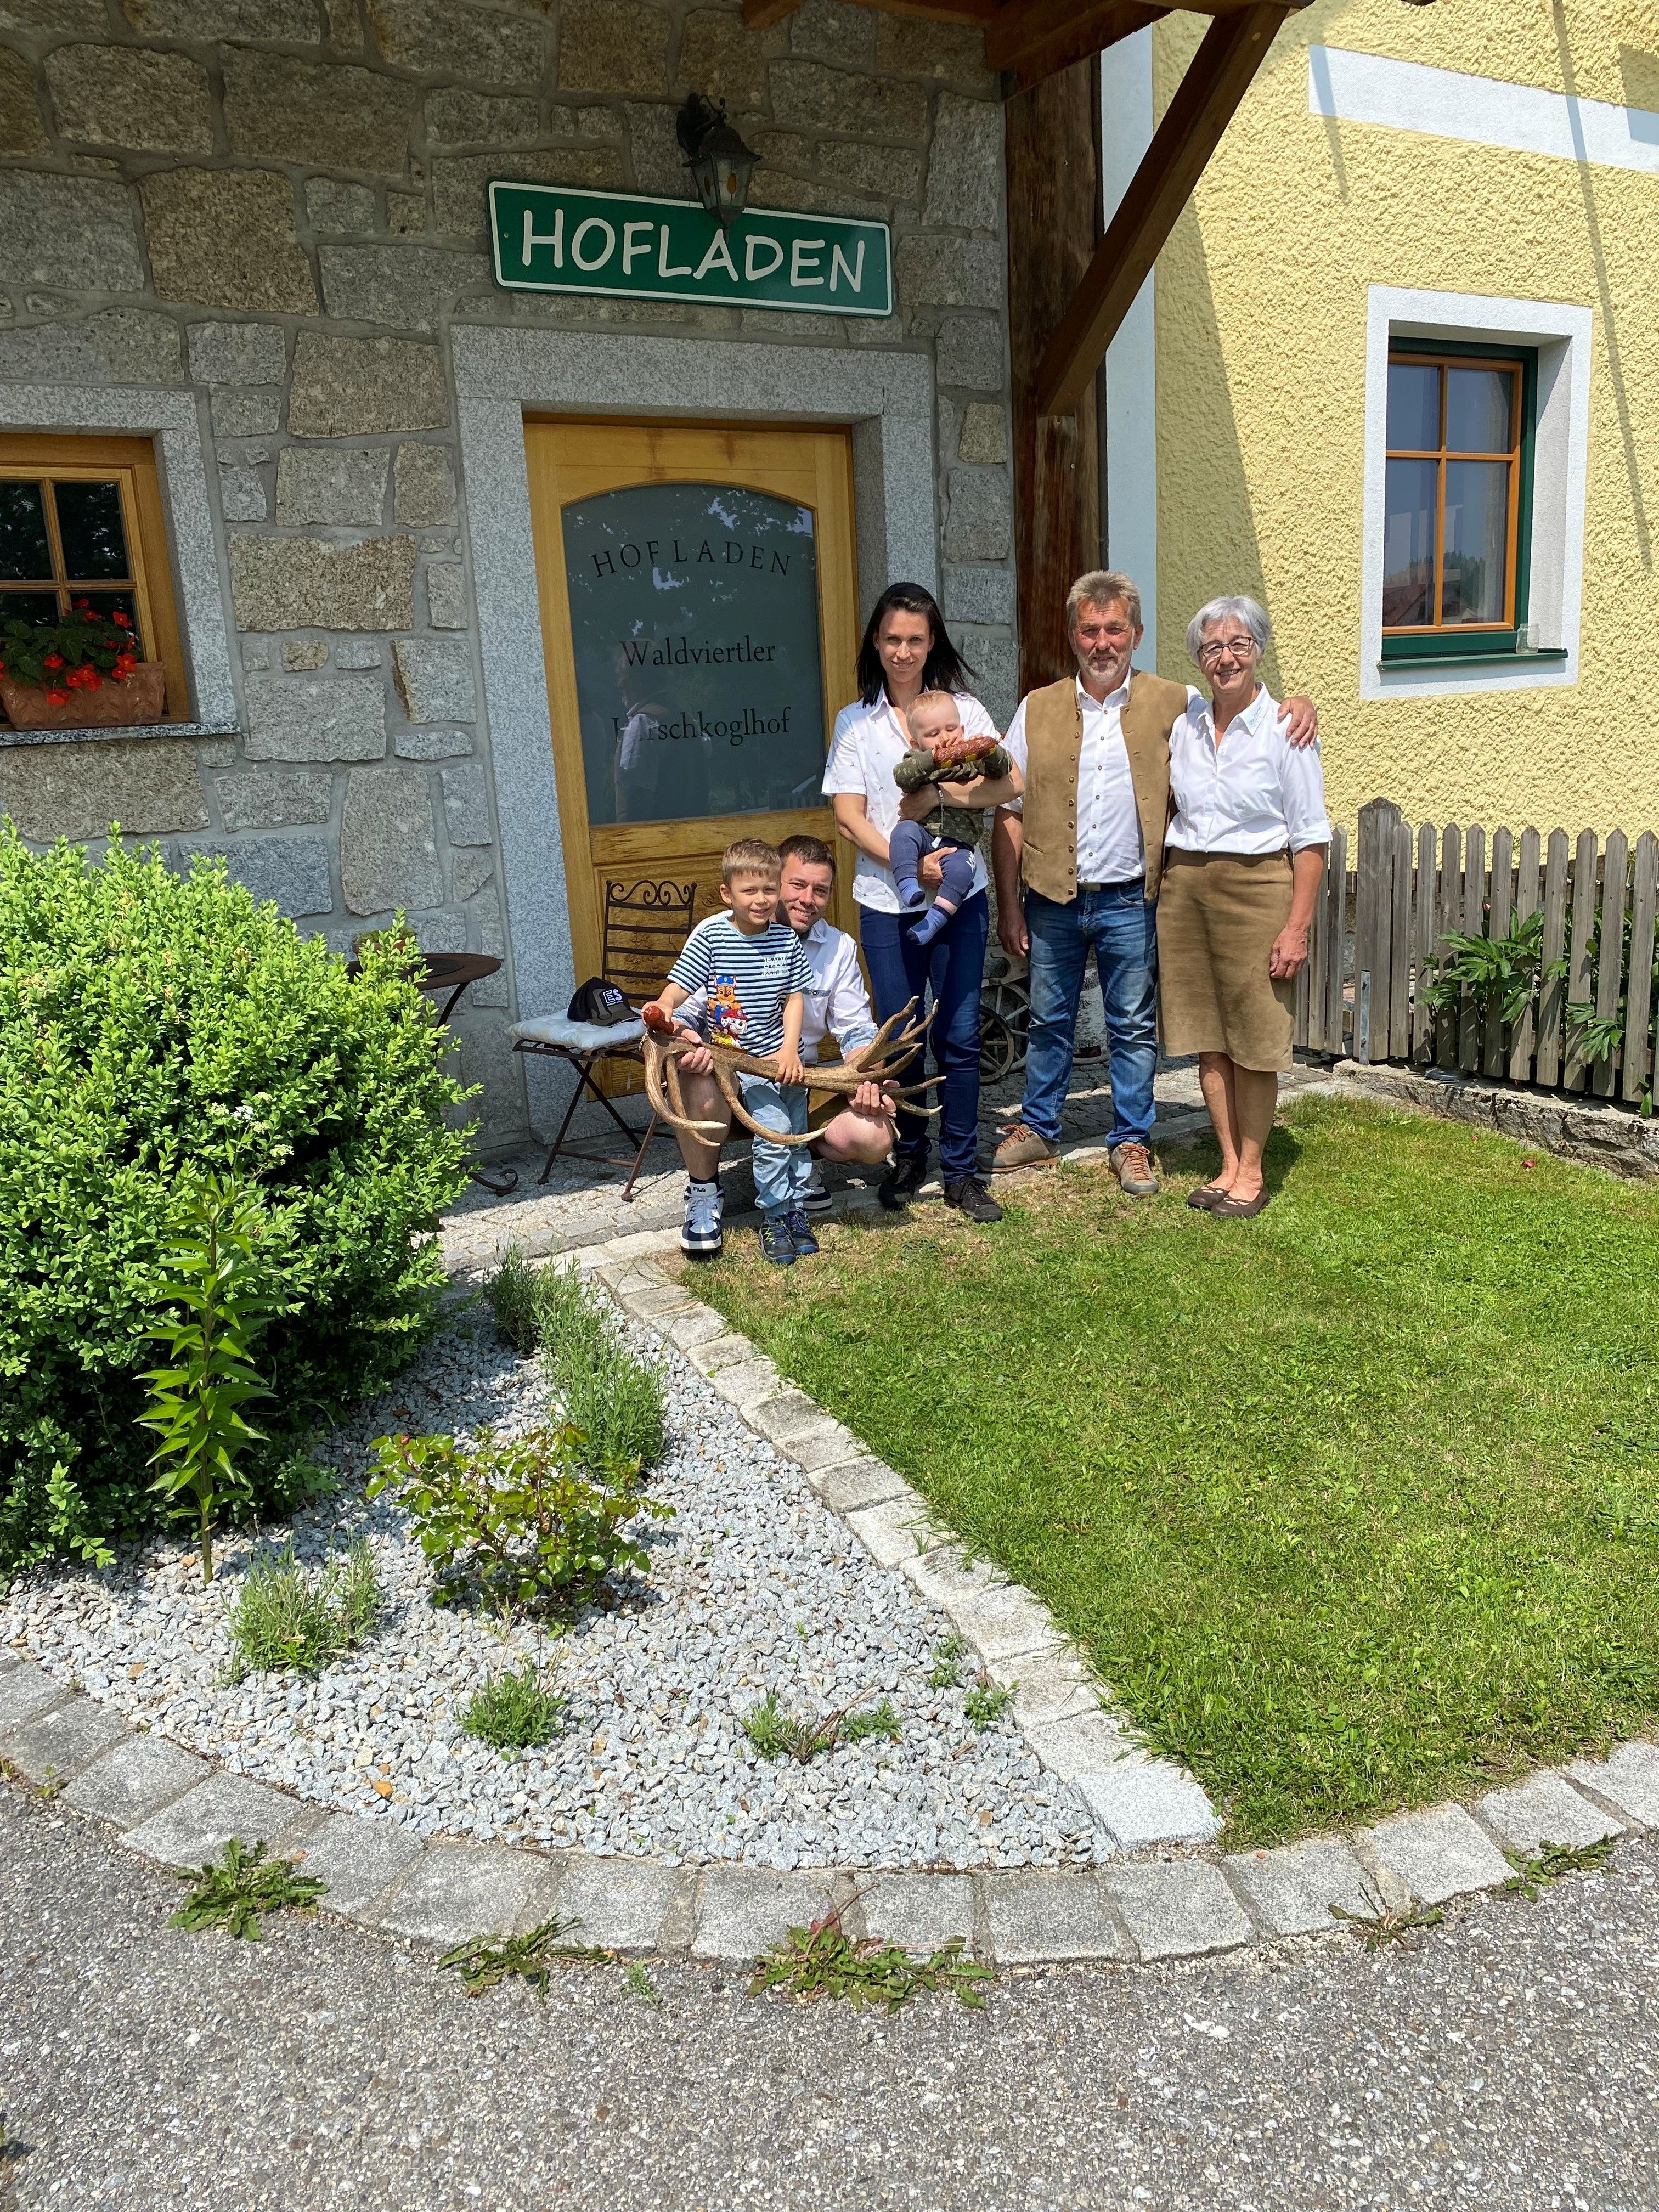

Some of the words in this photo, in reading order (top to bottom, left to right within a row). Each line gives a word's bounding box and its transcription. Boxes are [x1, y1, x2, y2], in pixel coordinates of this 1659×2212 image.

[522, 208, 865, 293] HOFLADEN
[591, 539, 791, 577] HOFLADEN
[619, 634, 776, 666] Waldviertler
[611, 707, 791, 746] Hschkoglhof
[603, 989, 622, 1003] ES
